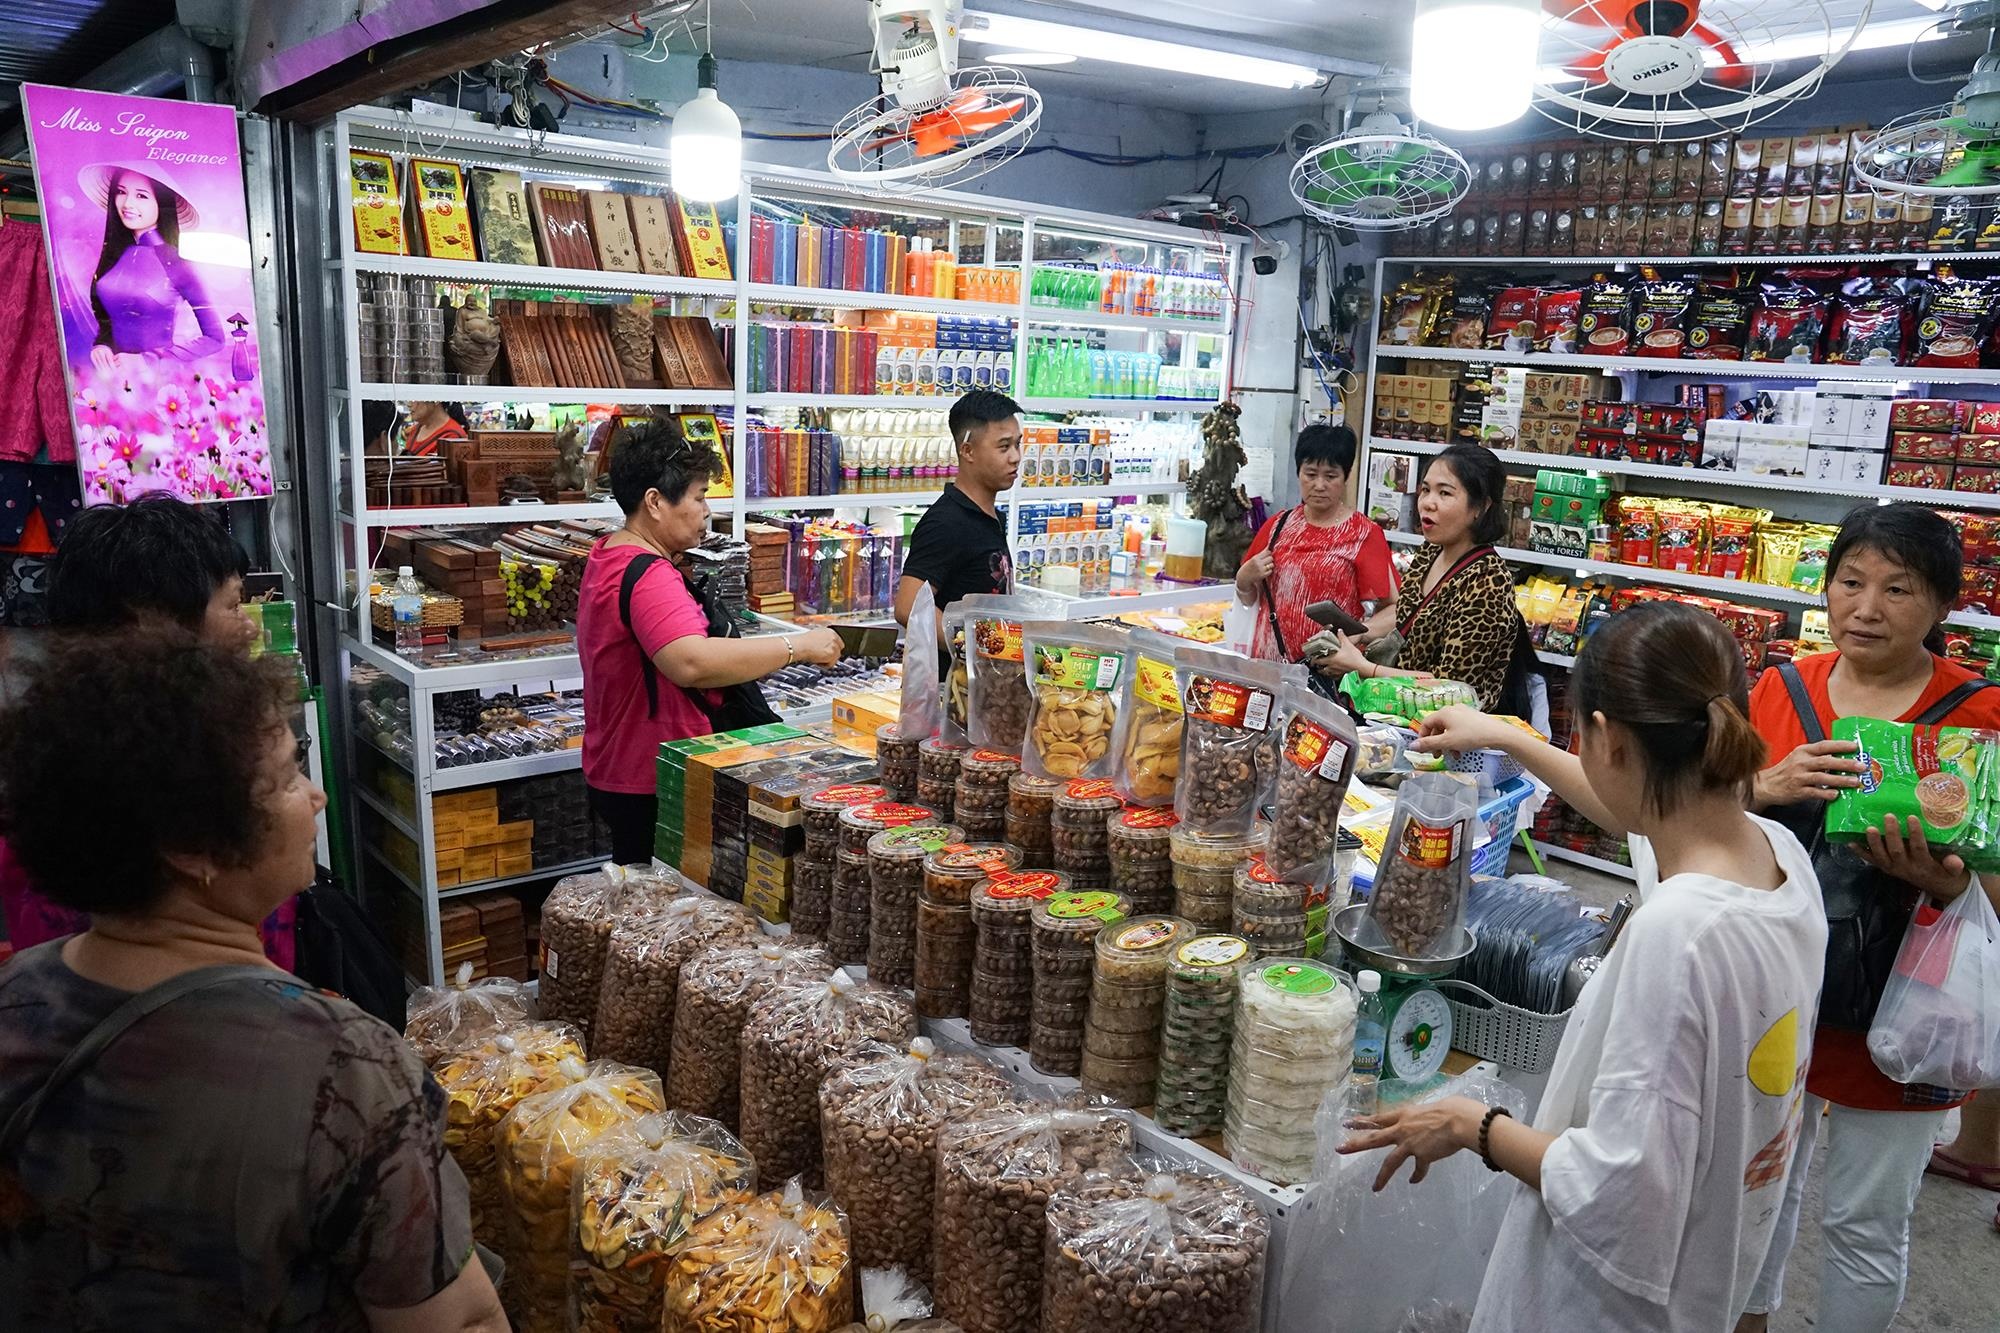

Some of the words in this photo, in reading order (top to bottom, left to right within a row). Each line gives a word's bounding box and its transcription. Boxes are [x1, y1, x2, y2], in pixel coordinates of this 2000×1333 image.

[40, 106, 102, 132] Miss
[110, 112, 190, 146] Saigon
[146, 147, 228, 165] Elegance
[1556, 546, 1584, 558] FOREST
